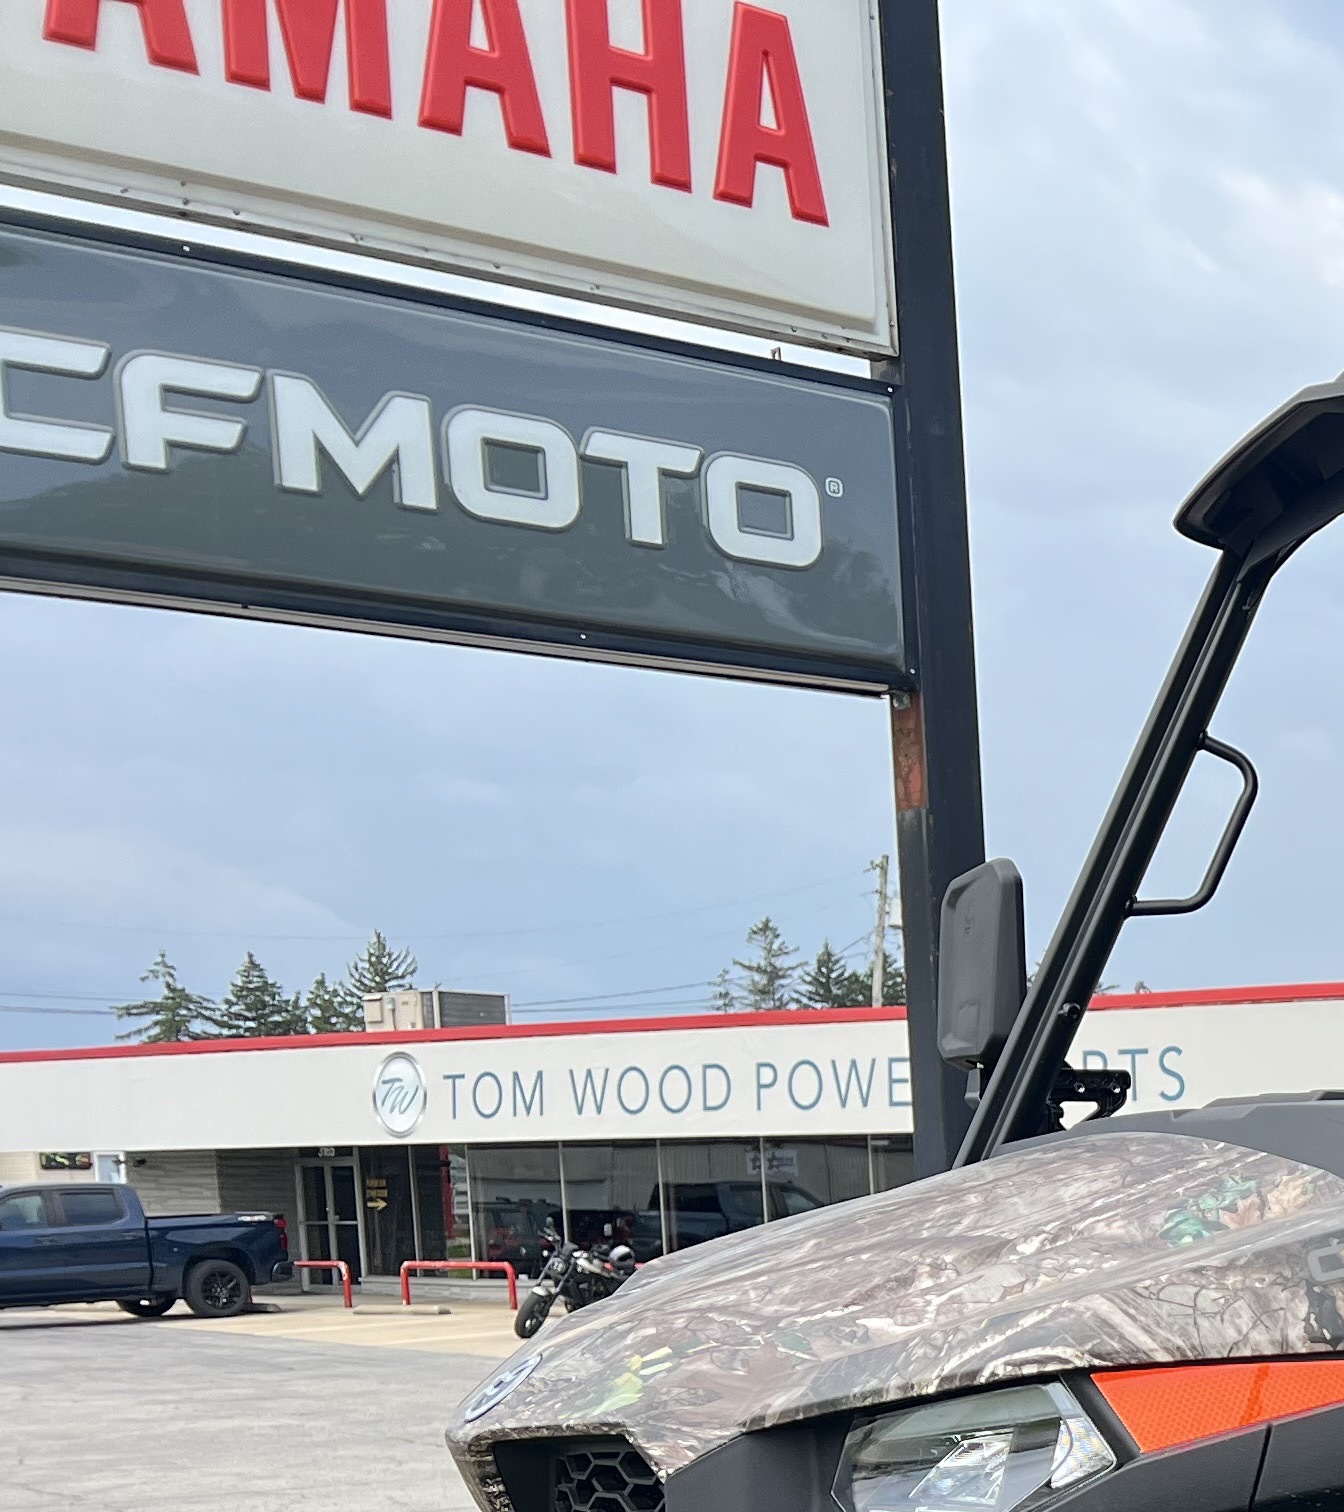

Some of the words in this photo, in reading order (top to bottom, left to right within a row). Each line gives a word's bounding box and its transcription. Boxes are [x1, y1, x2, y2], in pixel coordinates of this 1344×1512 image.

[43, 0, 829, 226] MAHA
[443, 1070, 544, 1119] TOM
[569, 1063, 731, 1115] WOOD
